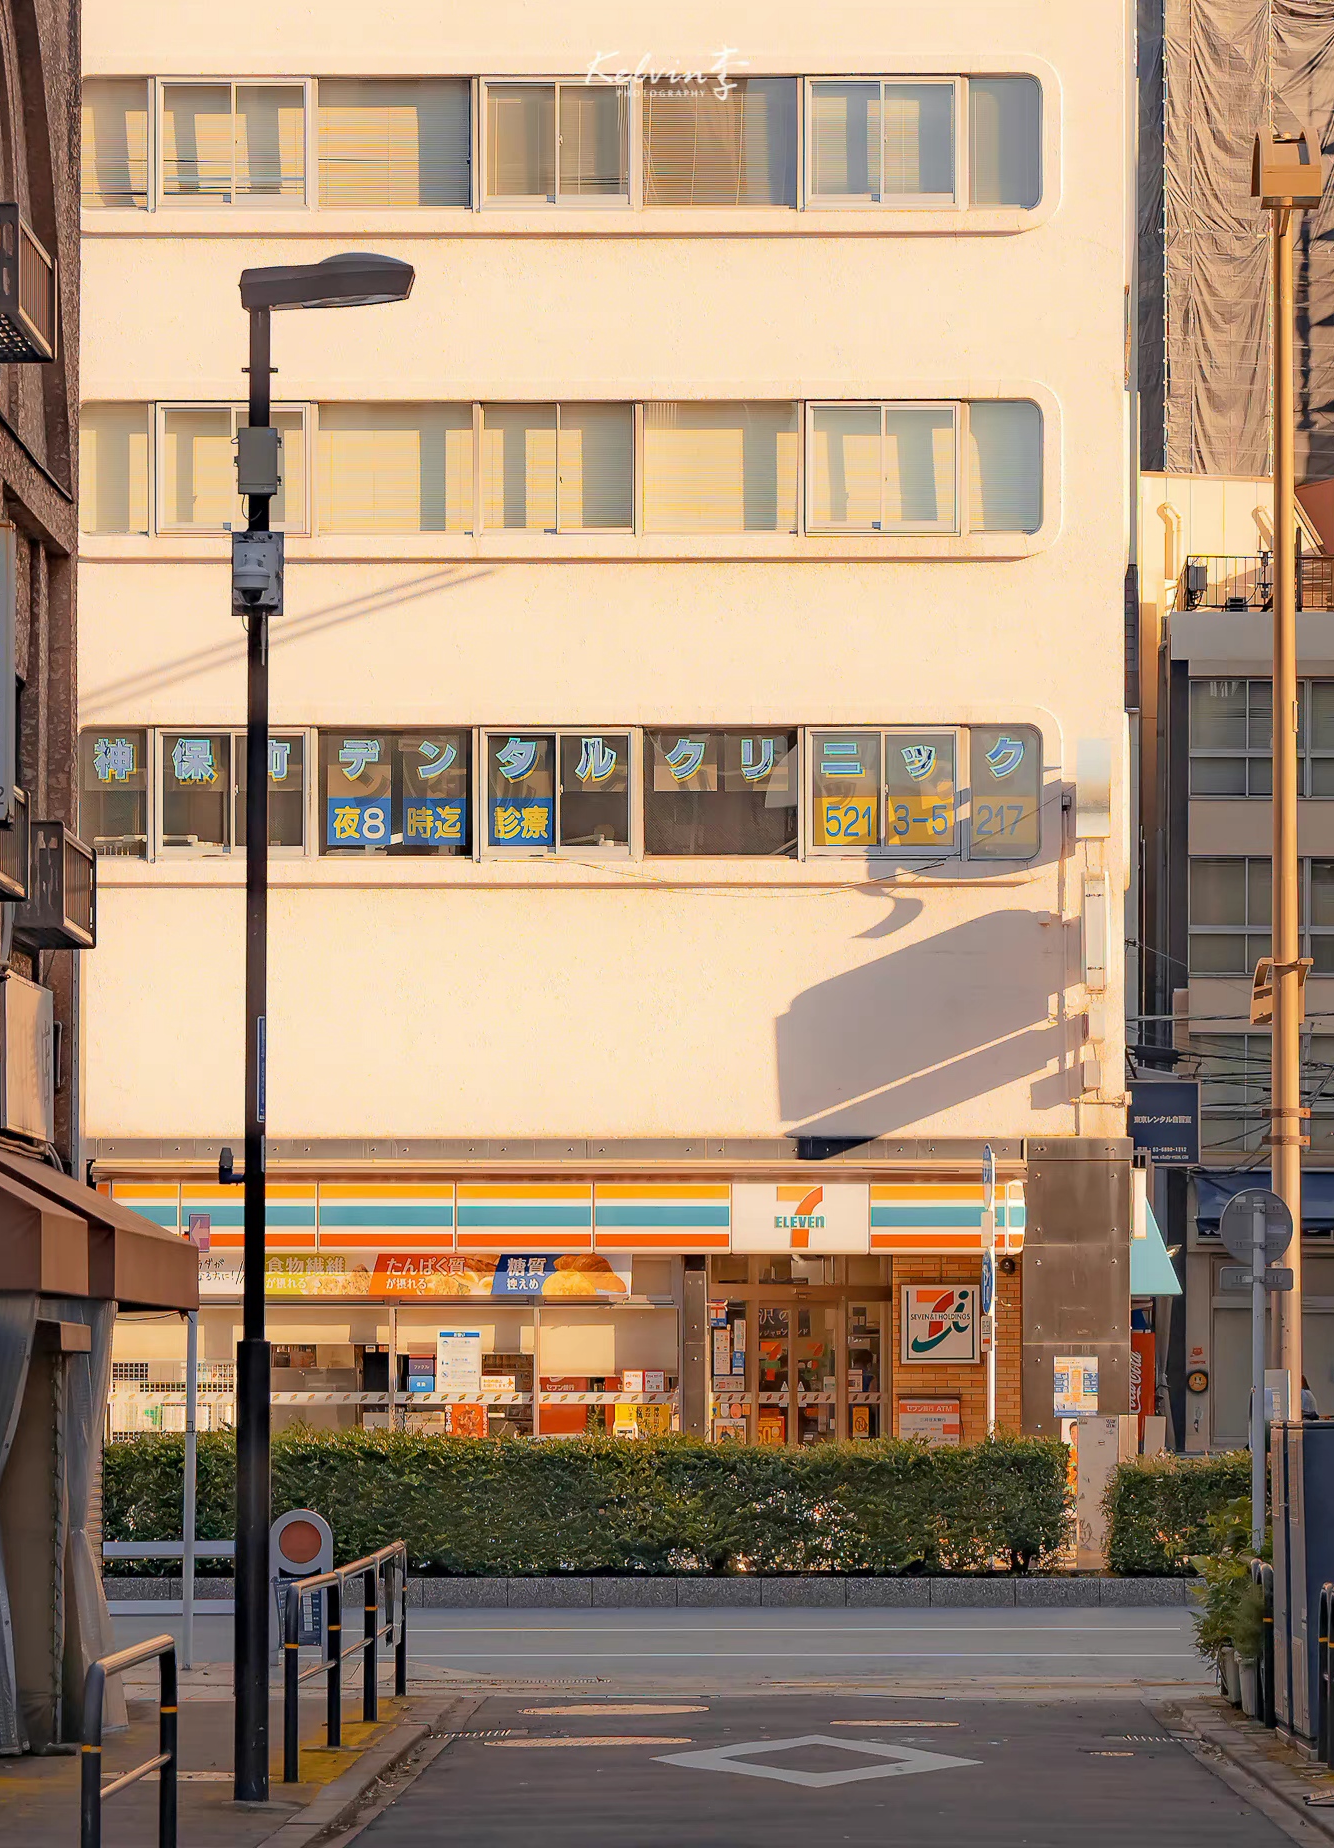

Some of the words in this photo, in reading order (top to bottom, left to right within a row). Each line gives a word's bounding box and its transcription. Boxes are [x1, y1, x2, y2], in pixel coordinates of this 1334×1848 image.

[266, 1256, 345, 1275] 食物繊維
[386, 1257, 466, 1276] たんぱく質
[506, 1257, 547, 1277] 糖質
